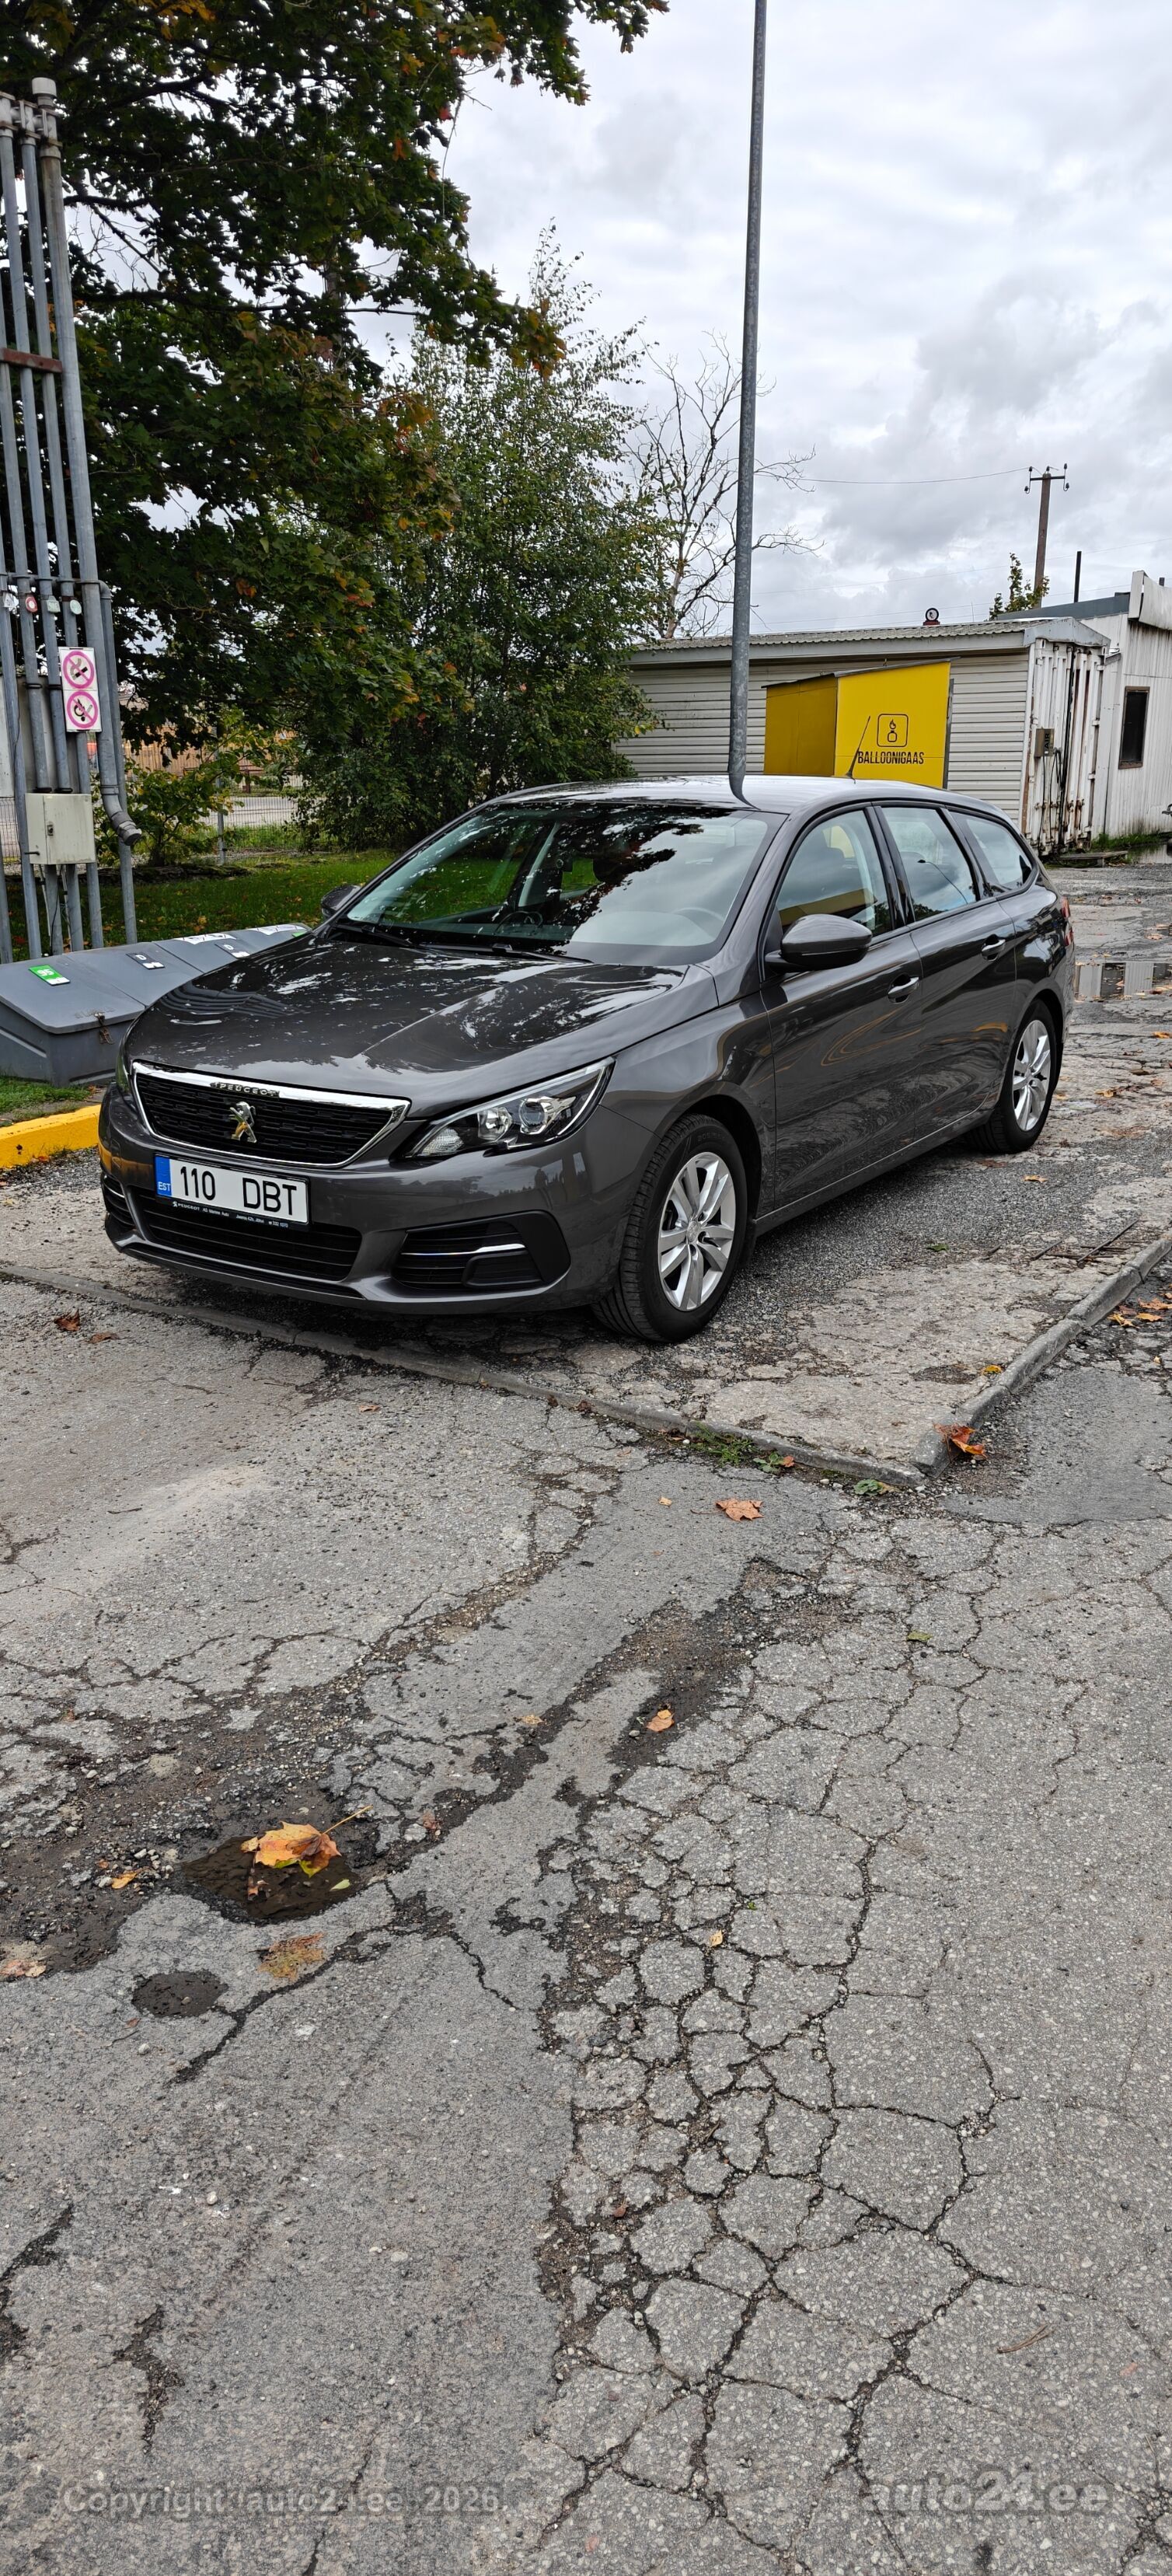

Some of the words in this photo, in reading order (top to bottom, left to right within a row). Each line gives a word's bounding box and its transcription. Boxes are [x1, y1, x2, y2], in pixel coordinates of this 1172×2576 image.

[857, 751, 924, 764] BALLOONIGAAS
[219, 1083, 277, 1096] PEUGEOT
[158, 1181, 171, 1192] EST
[180, 1166, 216, 1201] 110
[242, 1177, 297, 1215] DBT
